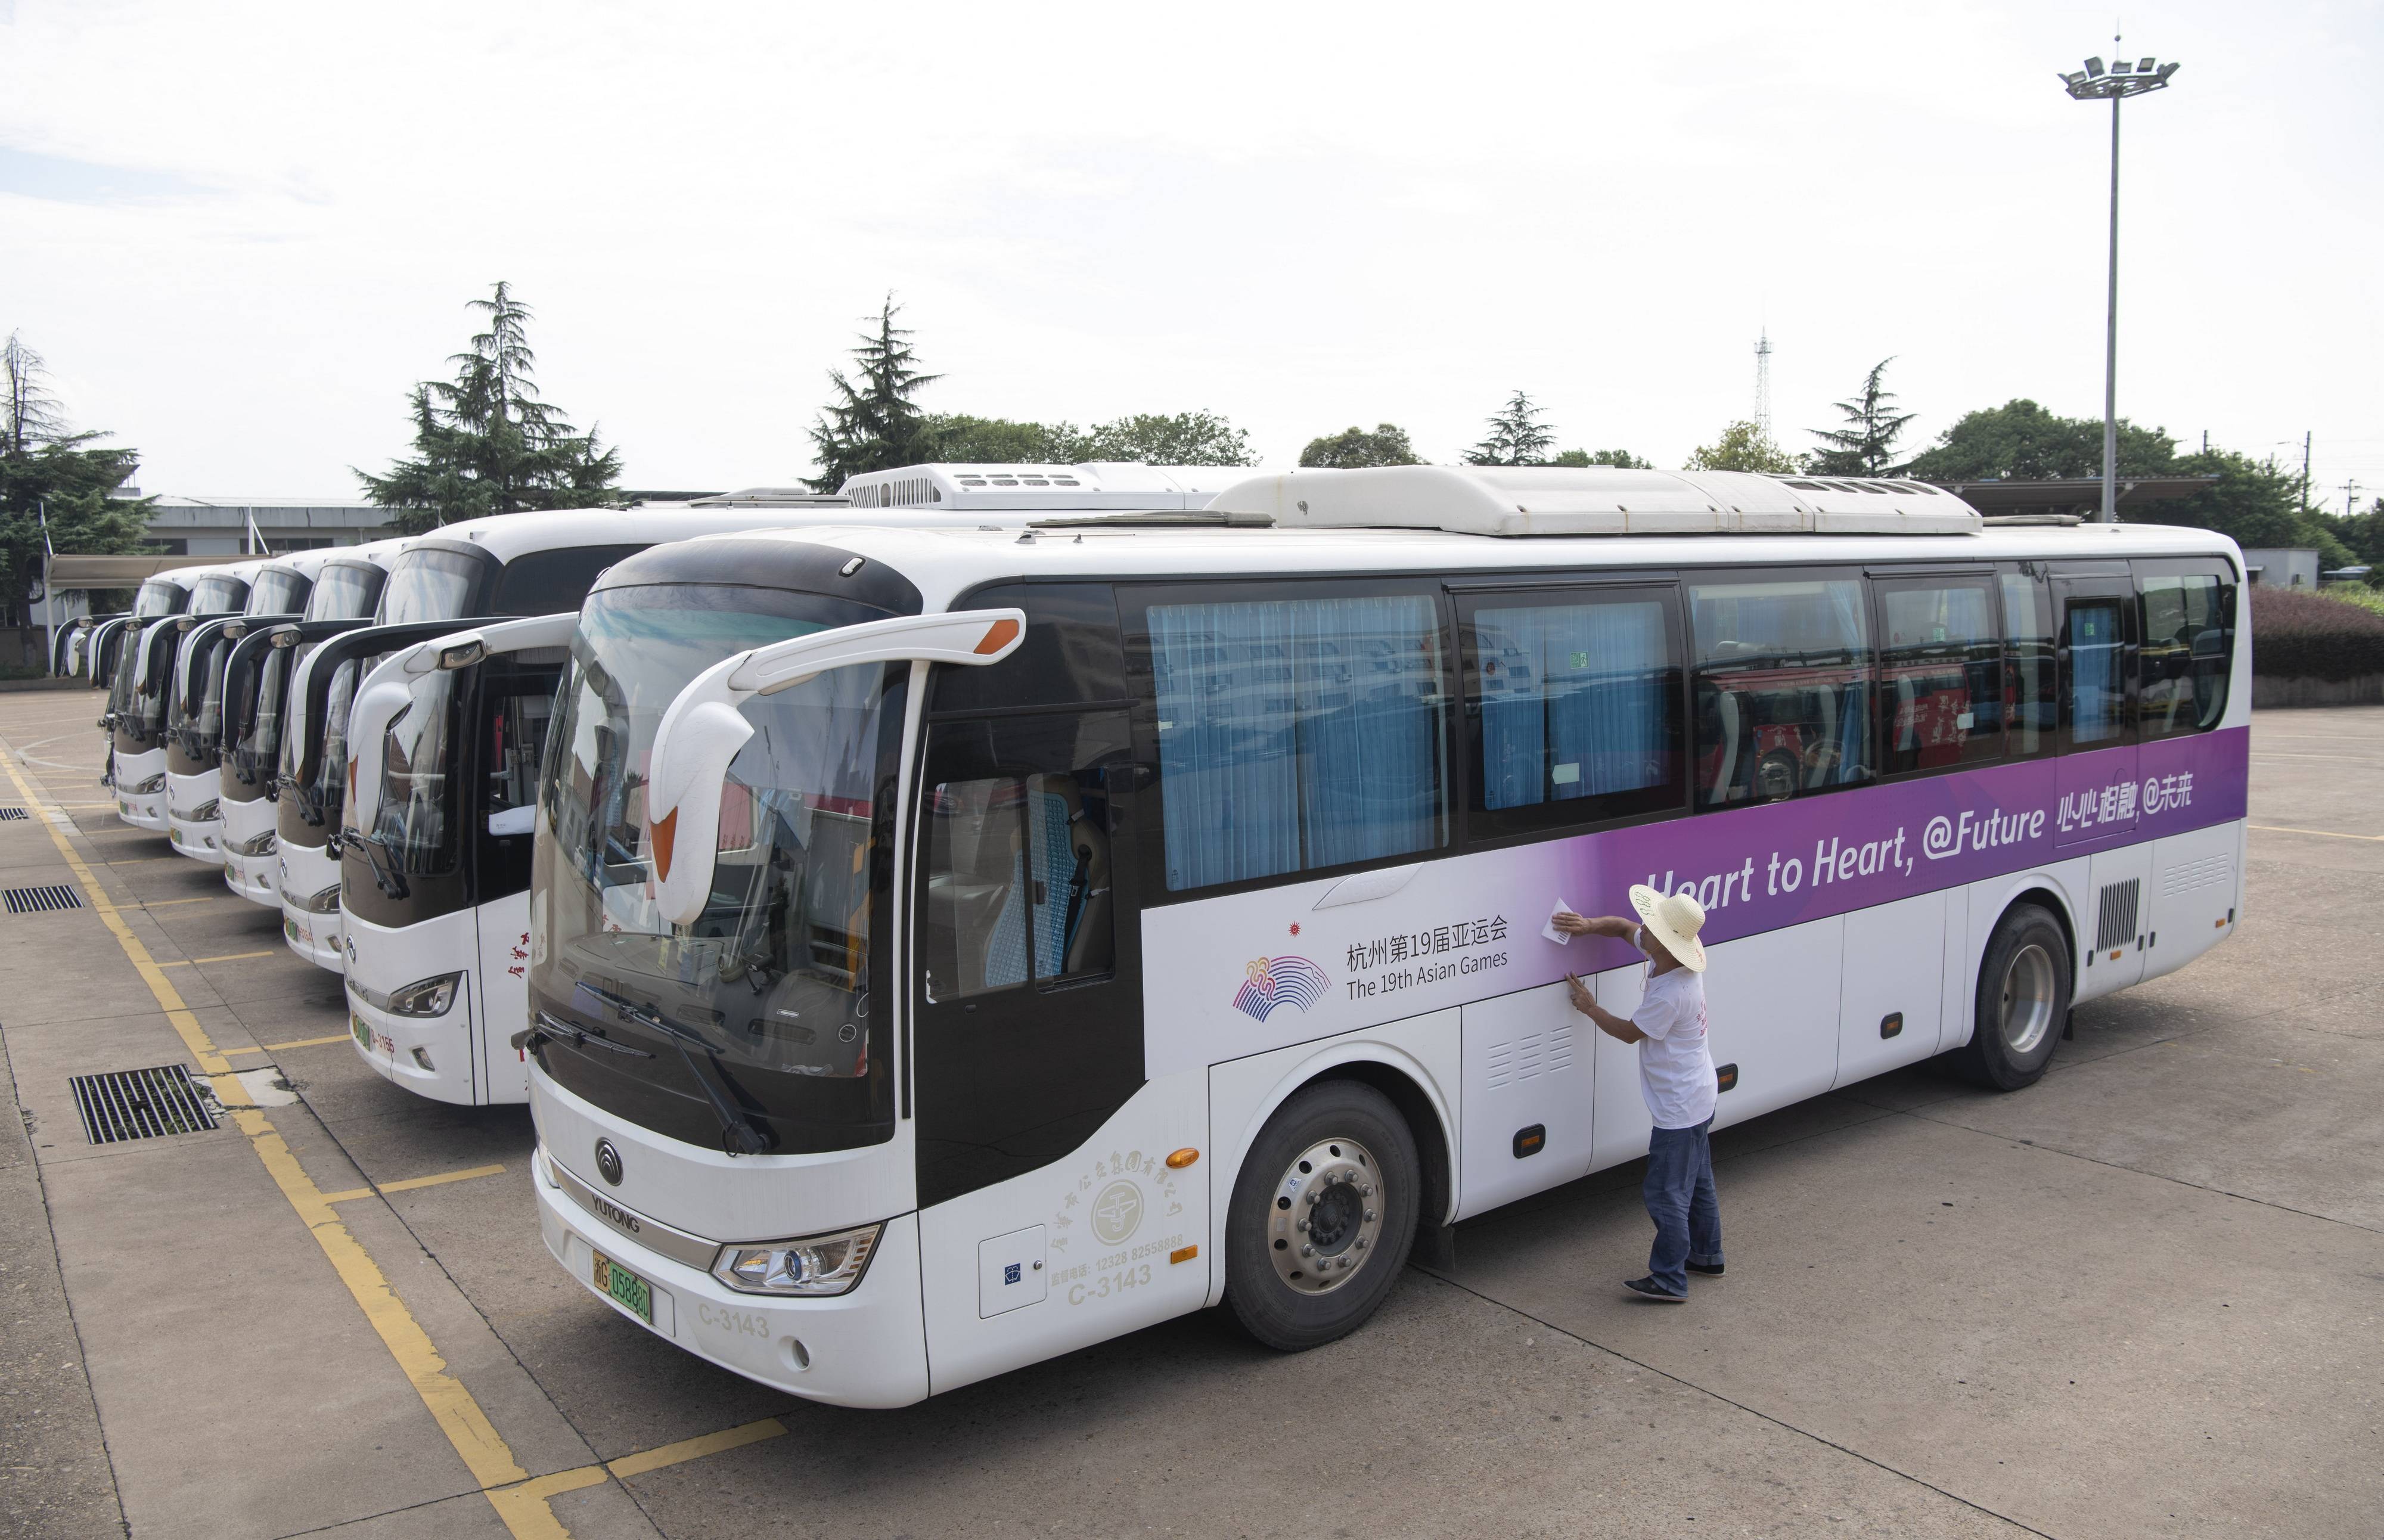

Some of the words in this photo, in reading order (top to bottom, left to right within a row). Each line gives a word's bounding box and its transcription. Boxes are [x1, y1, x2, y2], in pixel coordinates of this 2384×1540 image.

[1768, 852, 1802, 896] to
[1812, 827, 1913, 887] Heart,
[1923, 808, 2045, 859] @Future
[1346, 914, 1508, 973] 杭州第19届亚运会
[1346, 979, 1376, 1000] The
[1381, 968, 1413, 993] 19th
[1416, 962, 1456, 985] Asian
[1460, 952, 1507, 974] Games
[371, 1029, 395, 1053] B-3155
[591, 1194, 640, 1233] YUTONG
[1095, 1251, 1128, 1272] 12328
[1131, 1234, 1184, 1260] 82558888
[1067, 1264, 1151, 1305] C-3143
[699, 1303, 770, 1339] C-3143
